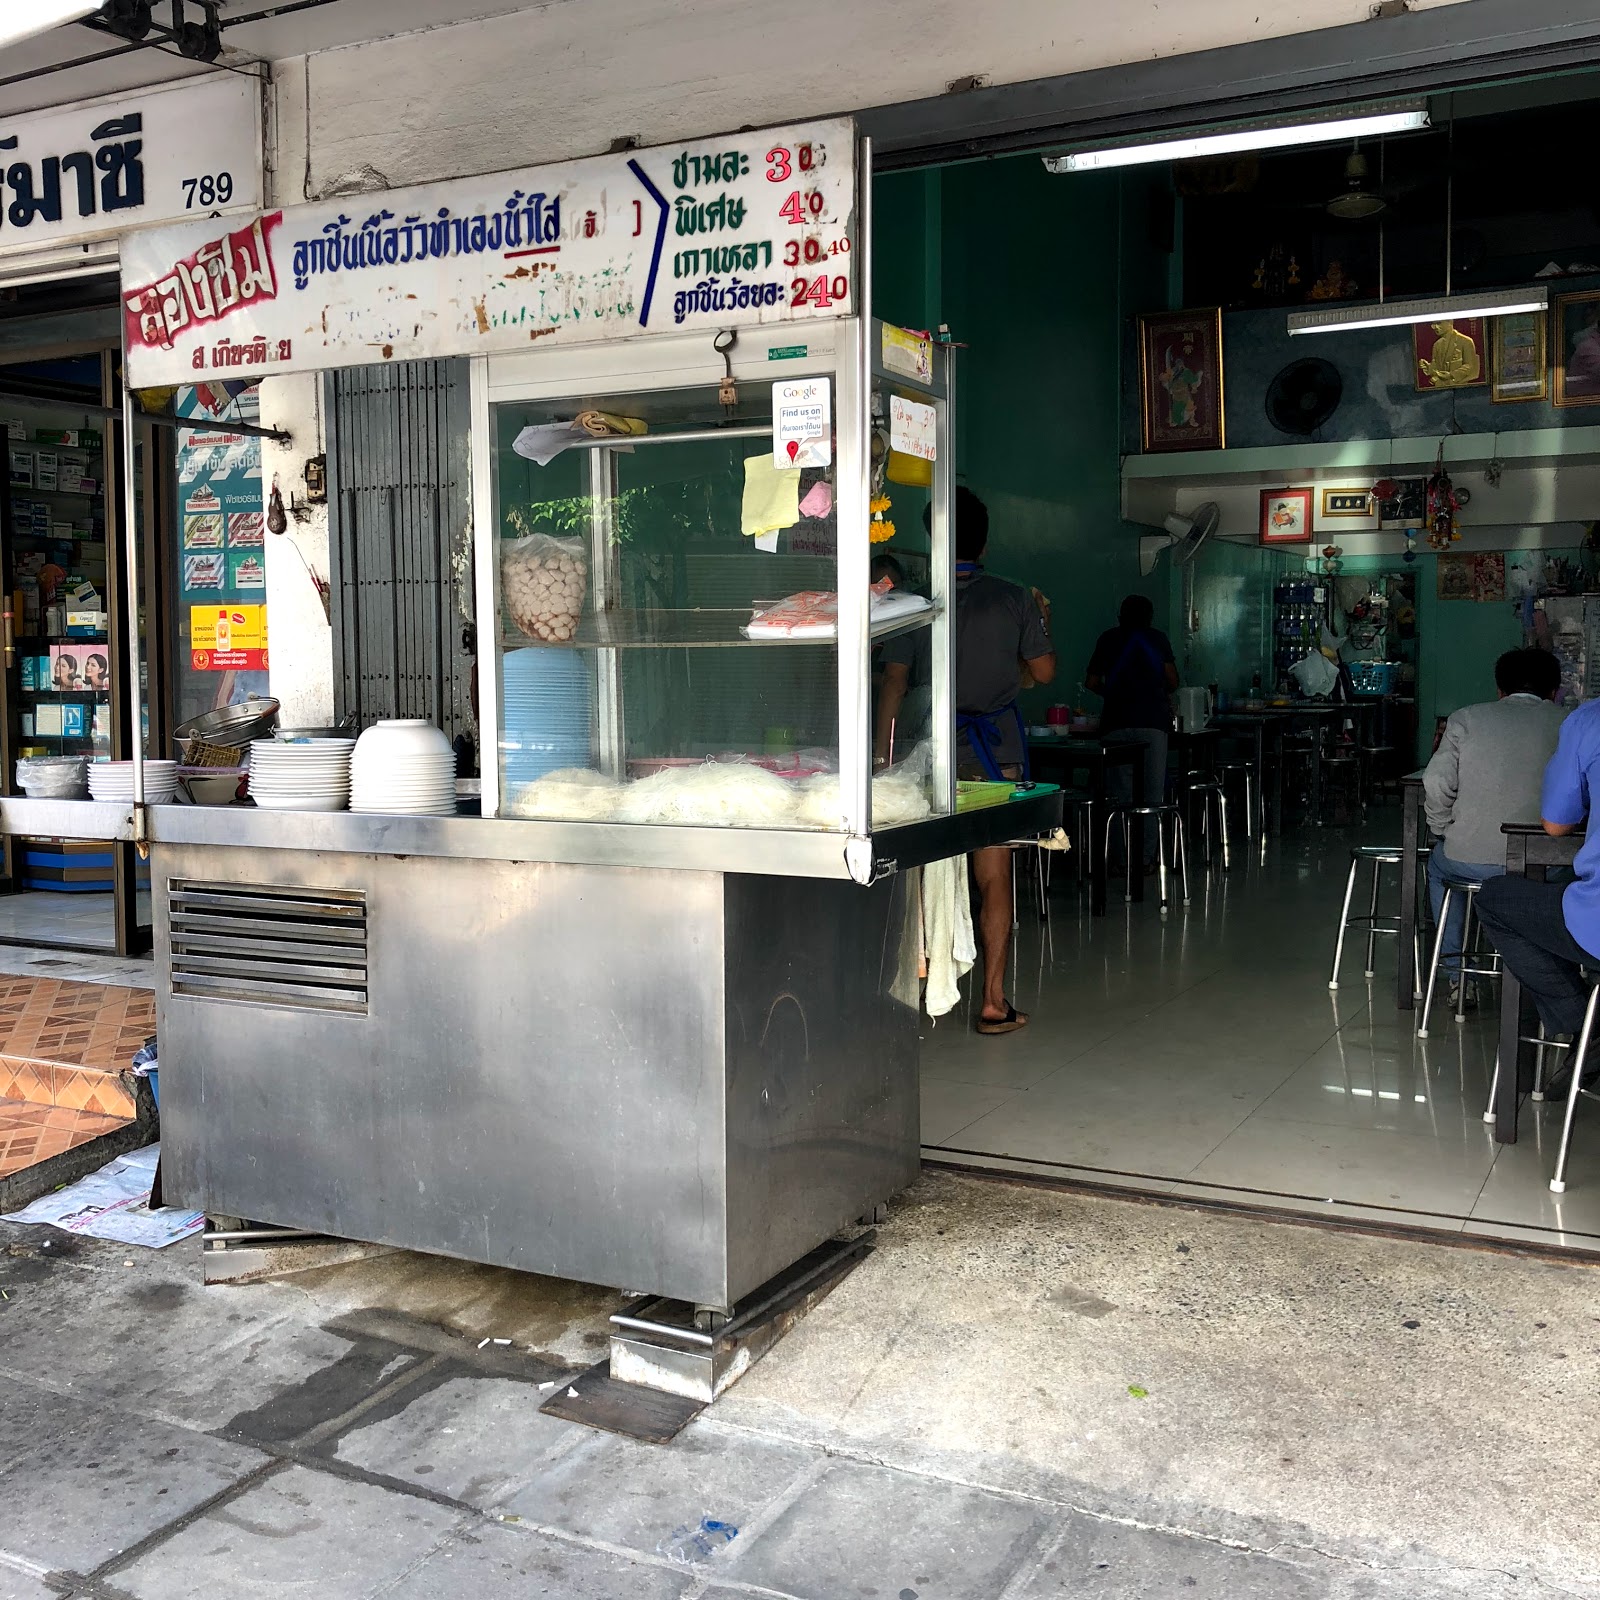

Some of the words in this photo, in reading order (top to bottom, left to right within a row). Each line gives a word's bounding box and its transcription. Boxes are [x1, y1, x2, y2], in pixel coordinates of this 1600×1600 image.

[672, 150, 750, 189] ชามละ
[182, 172, 233, 209] 789
[674, 192, 748, 237] พิเศษ
[674, 240, 772, 278] เกาเหลา
[674, 277, 784, 324] ลูกชิ้นร้อยละ
[790, 274, 848, 308] 240
[783, 384, 817, 400] Google
[782, 408, 798, 418] Find
[810, 408, 821, 416] on
